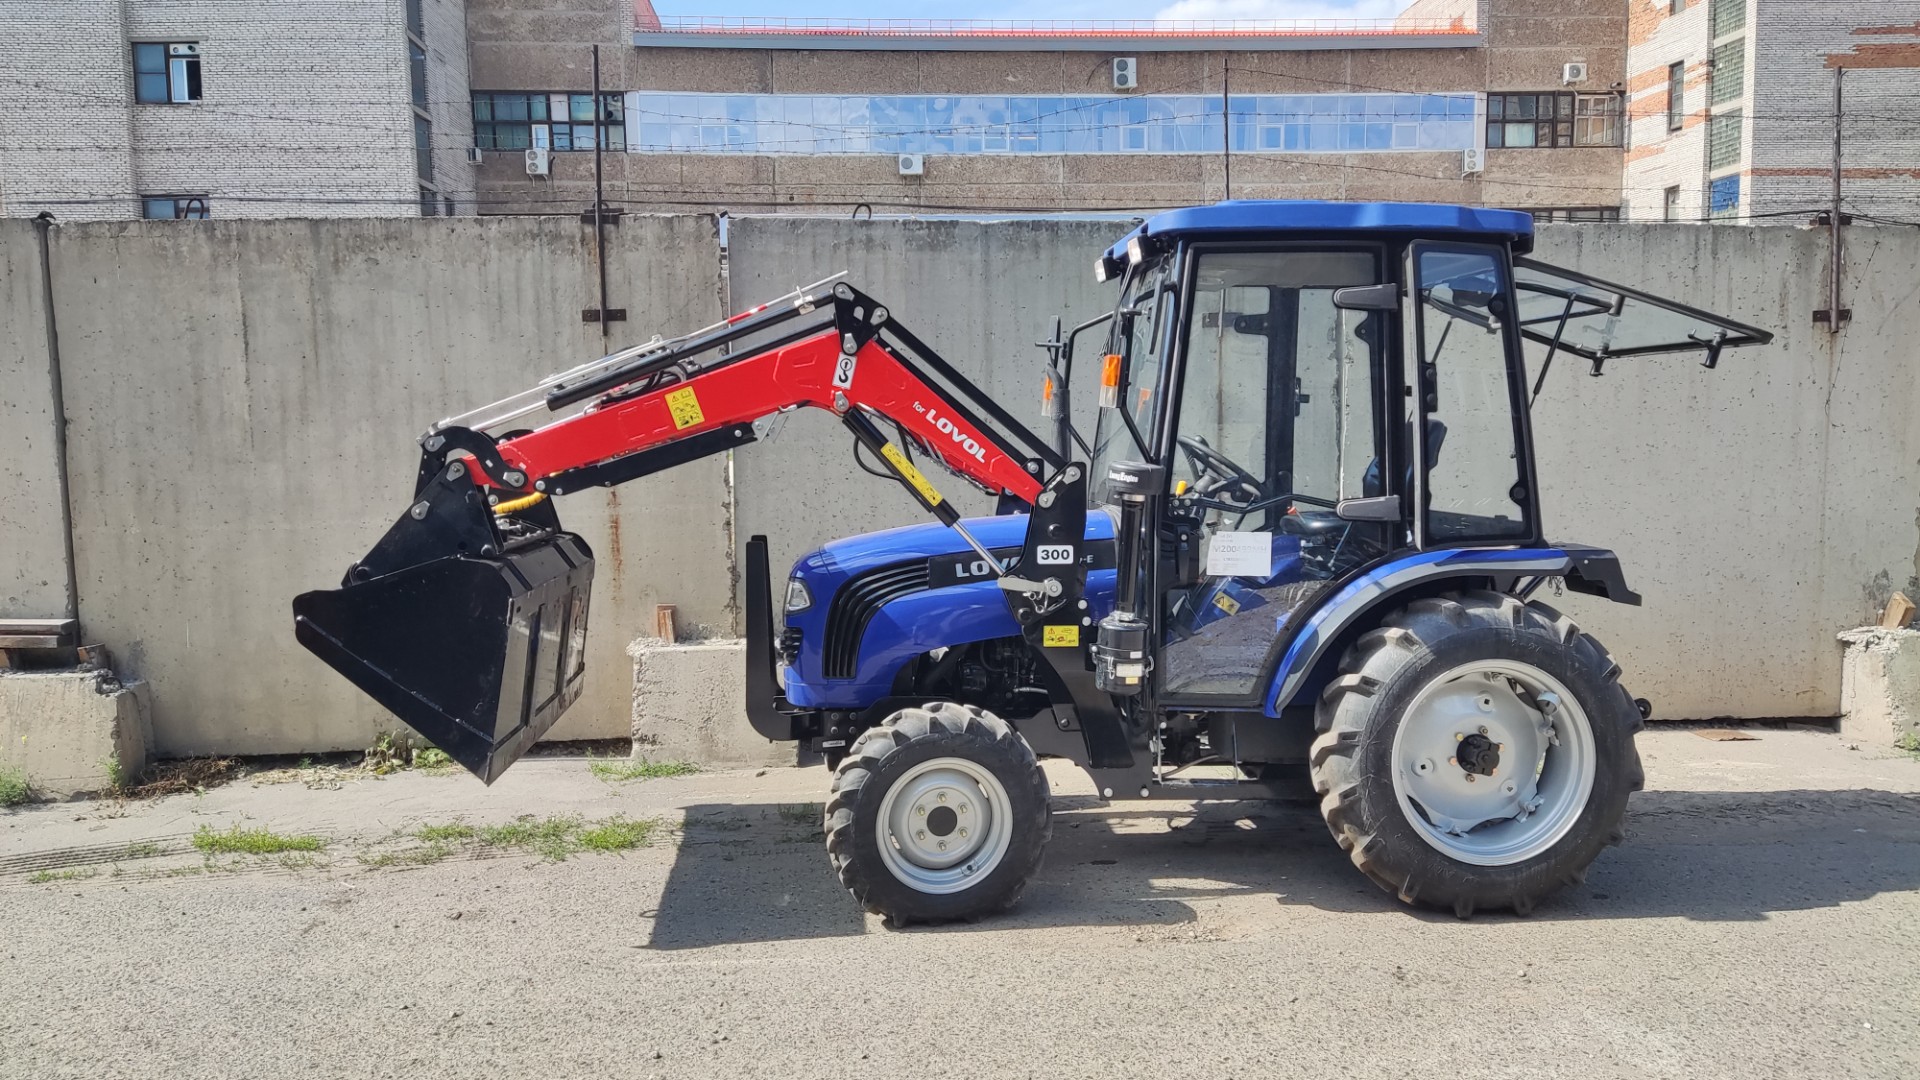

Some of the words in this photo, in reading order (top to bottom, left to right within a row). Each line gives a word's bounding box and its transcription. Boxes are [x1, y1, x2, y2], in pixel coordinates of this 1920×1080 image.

[912, 400, 926, 413] for
[925, 408, 986, 464] LOVOL
[1041, 549, 1070, 560] 300
[955, 556, 1021, 578] LO
